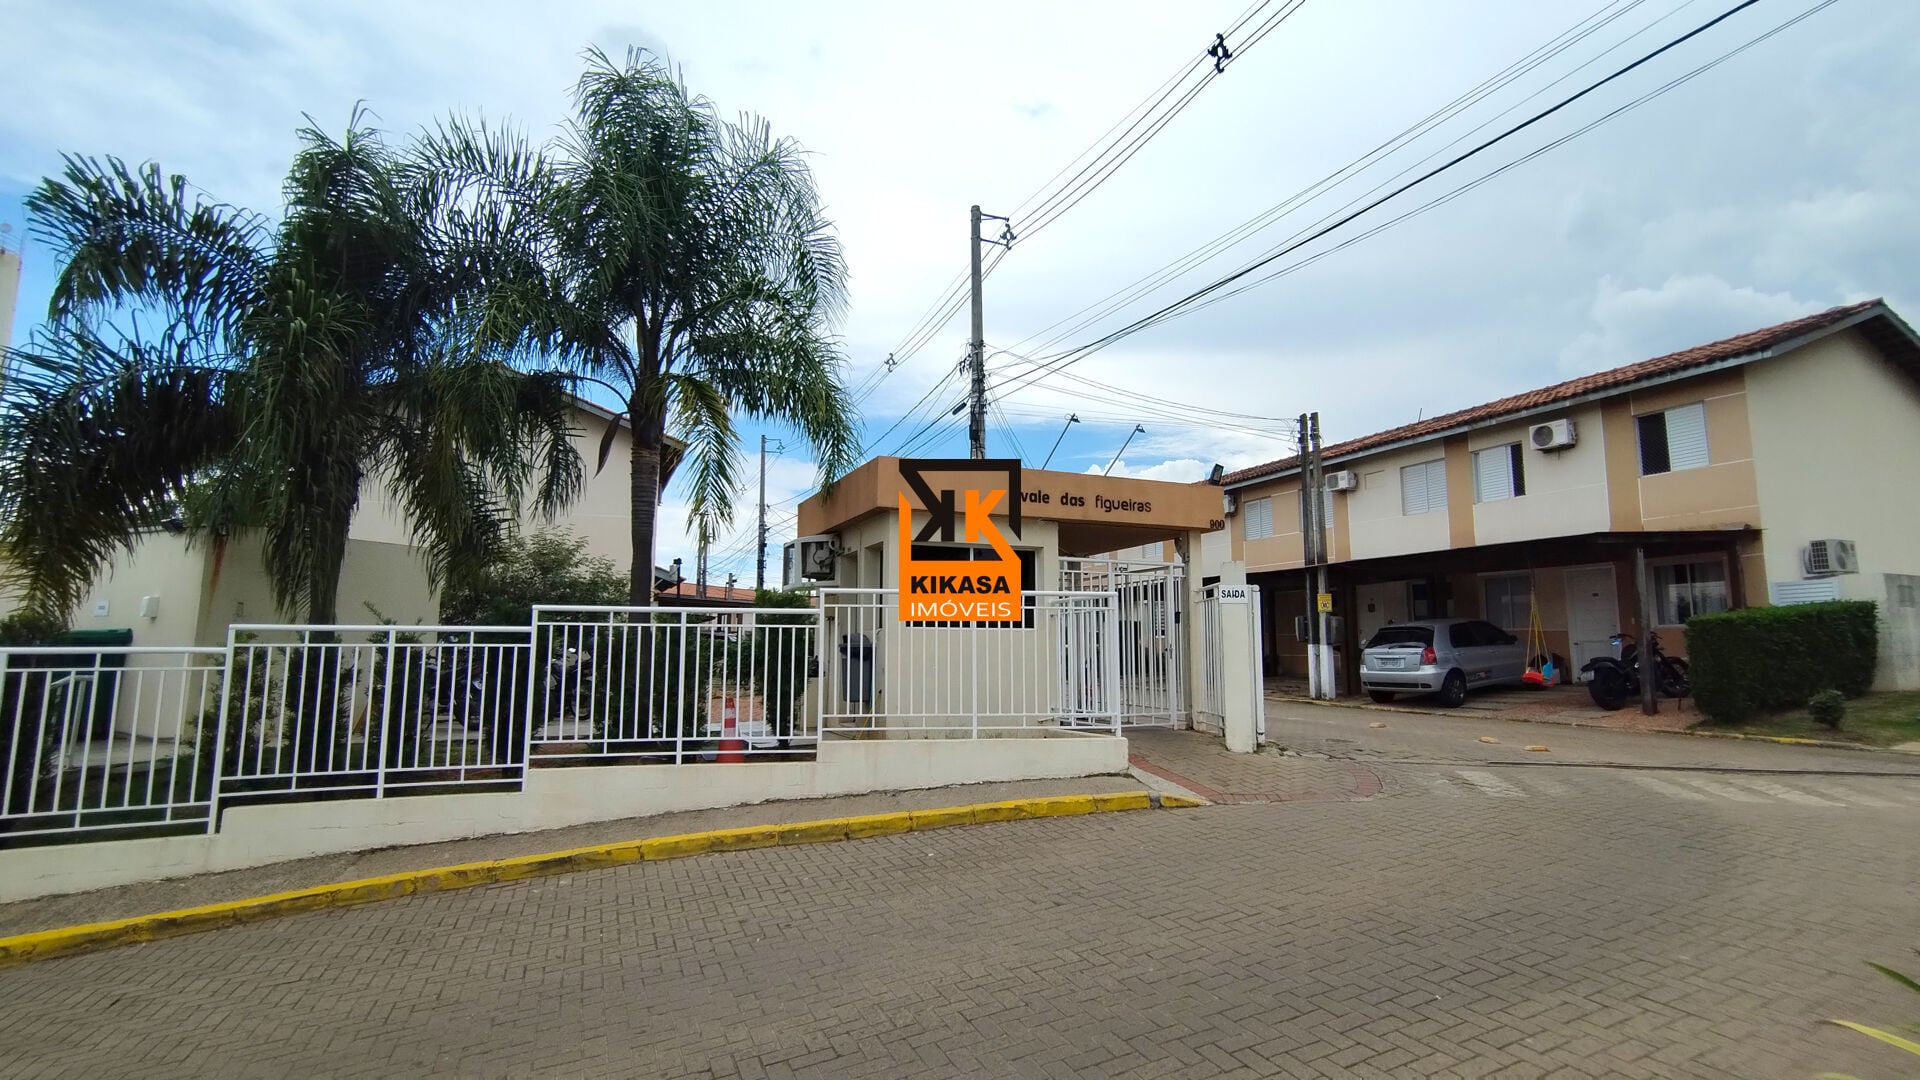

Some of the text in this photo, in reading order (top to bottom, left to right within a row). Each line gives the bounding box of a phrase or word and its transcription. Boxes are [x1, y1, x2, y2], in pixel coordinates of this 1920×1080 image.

[1020, 490, 1152, 512] vale das figueiras
[1209, 519, 1225, 529] 900
